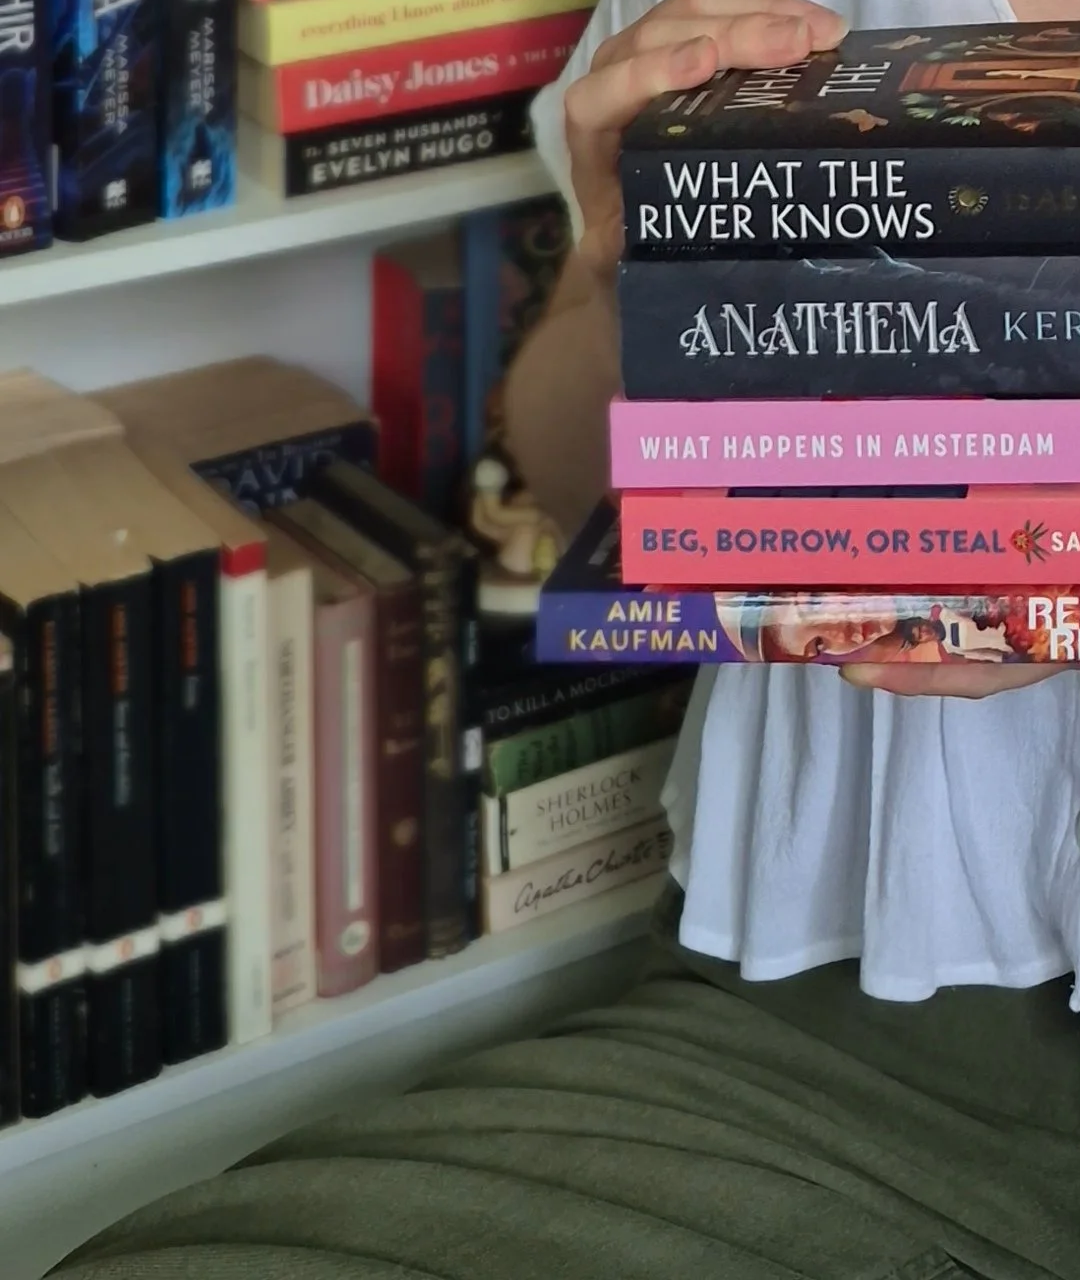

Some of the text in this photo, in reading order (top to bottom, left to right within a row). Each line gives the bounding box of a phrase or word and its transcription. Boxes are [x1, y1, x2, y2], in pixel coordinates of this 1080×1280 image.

[300, 7, 387, 39] everything
[104, 48, 117, 126] MEYER
[116, 34, 130, 135] MARISSA
[189, 30, 203, 108] MEYER
[203, 17, 216, 115] MARISSA
[304, 47, 548, 111] Daisy Jones THE
[816, 60, 892, 97] THE
[326, 111, 489, 155] SEVEN HUSBANDS
[310, 129, 495, 184] EVELYN HUGO
[663, 159, 907, 199] WHAT THE
[637, 202, 936, 241] RIVER KNOWS
[679, 300, 982, 358] ANATHEMA
[639, 431, 1055, 461] WHAT HAPPENS IN AMSTERDAM
[641, 528, 709, 558] BEG,
[715, 528, 860, 560] BORROW,
[866, 528, 911, 554] OR
[918, 528, 1007, 555] STEAL
[606, 600, 682, 623] AMIE
[568, 628, 718, 653] KAUFMAN
[487, 687, 567, 724] TO KILL A
[536, 767, 642, 817] SHERLOCK
[550, 792, 633, 833] HOLMES
[513, 868, 584, 915] Agatha
